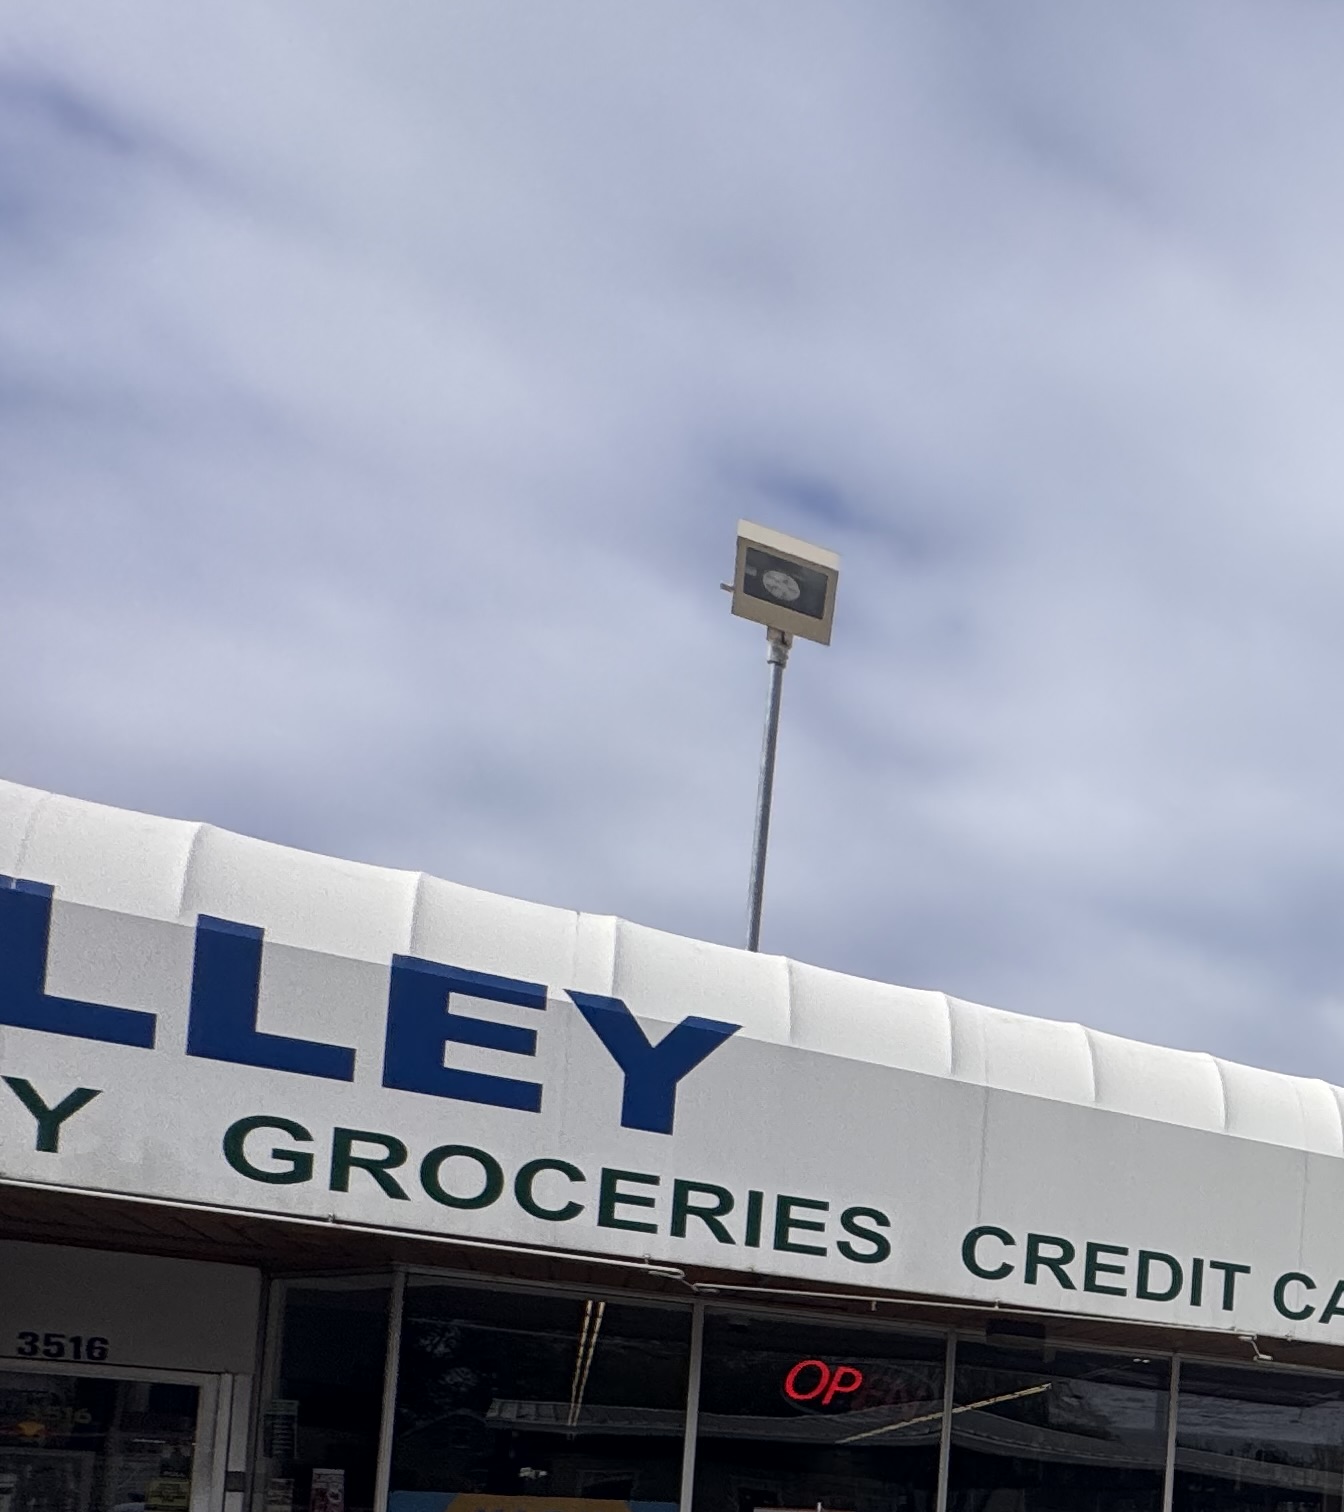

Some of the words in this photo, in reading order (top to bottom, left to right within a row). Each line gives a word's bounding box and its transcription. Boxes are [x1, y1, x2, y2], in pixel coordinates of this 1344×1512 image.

[0, 873, 743, 1135] LLEY
[2, 1075, 103, 1153] Y
[223, 1115, 892, 1264] GROCERIES
[961, 1225, 1251, 1312] CREDIT
[17, 1331, 109, 1362] 3516
